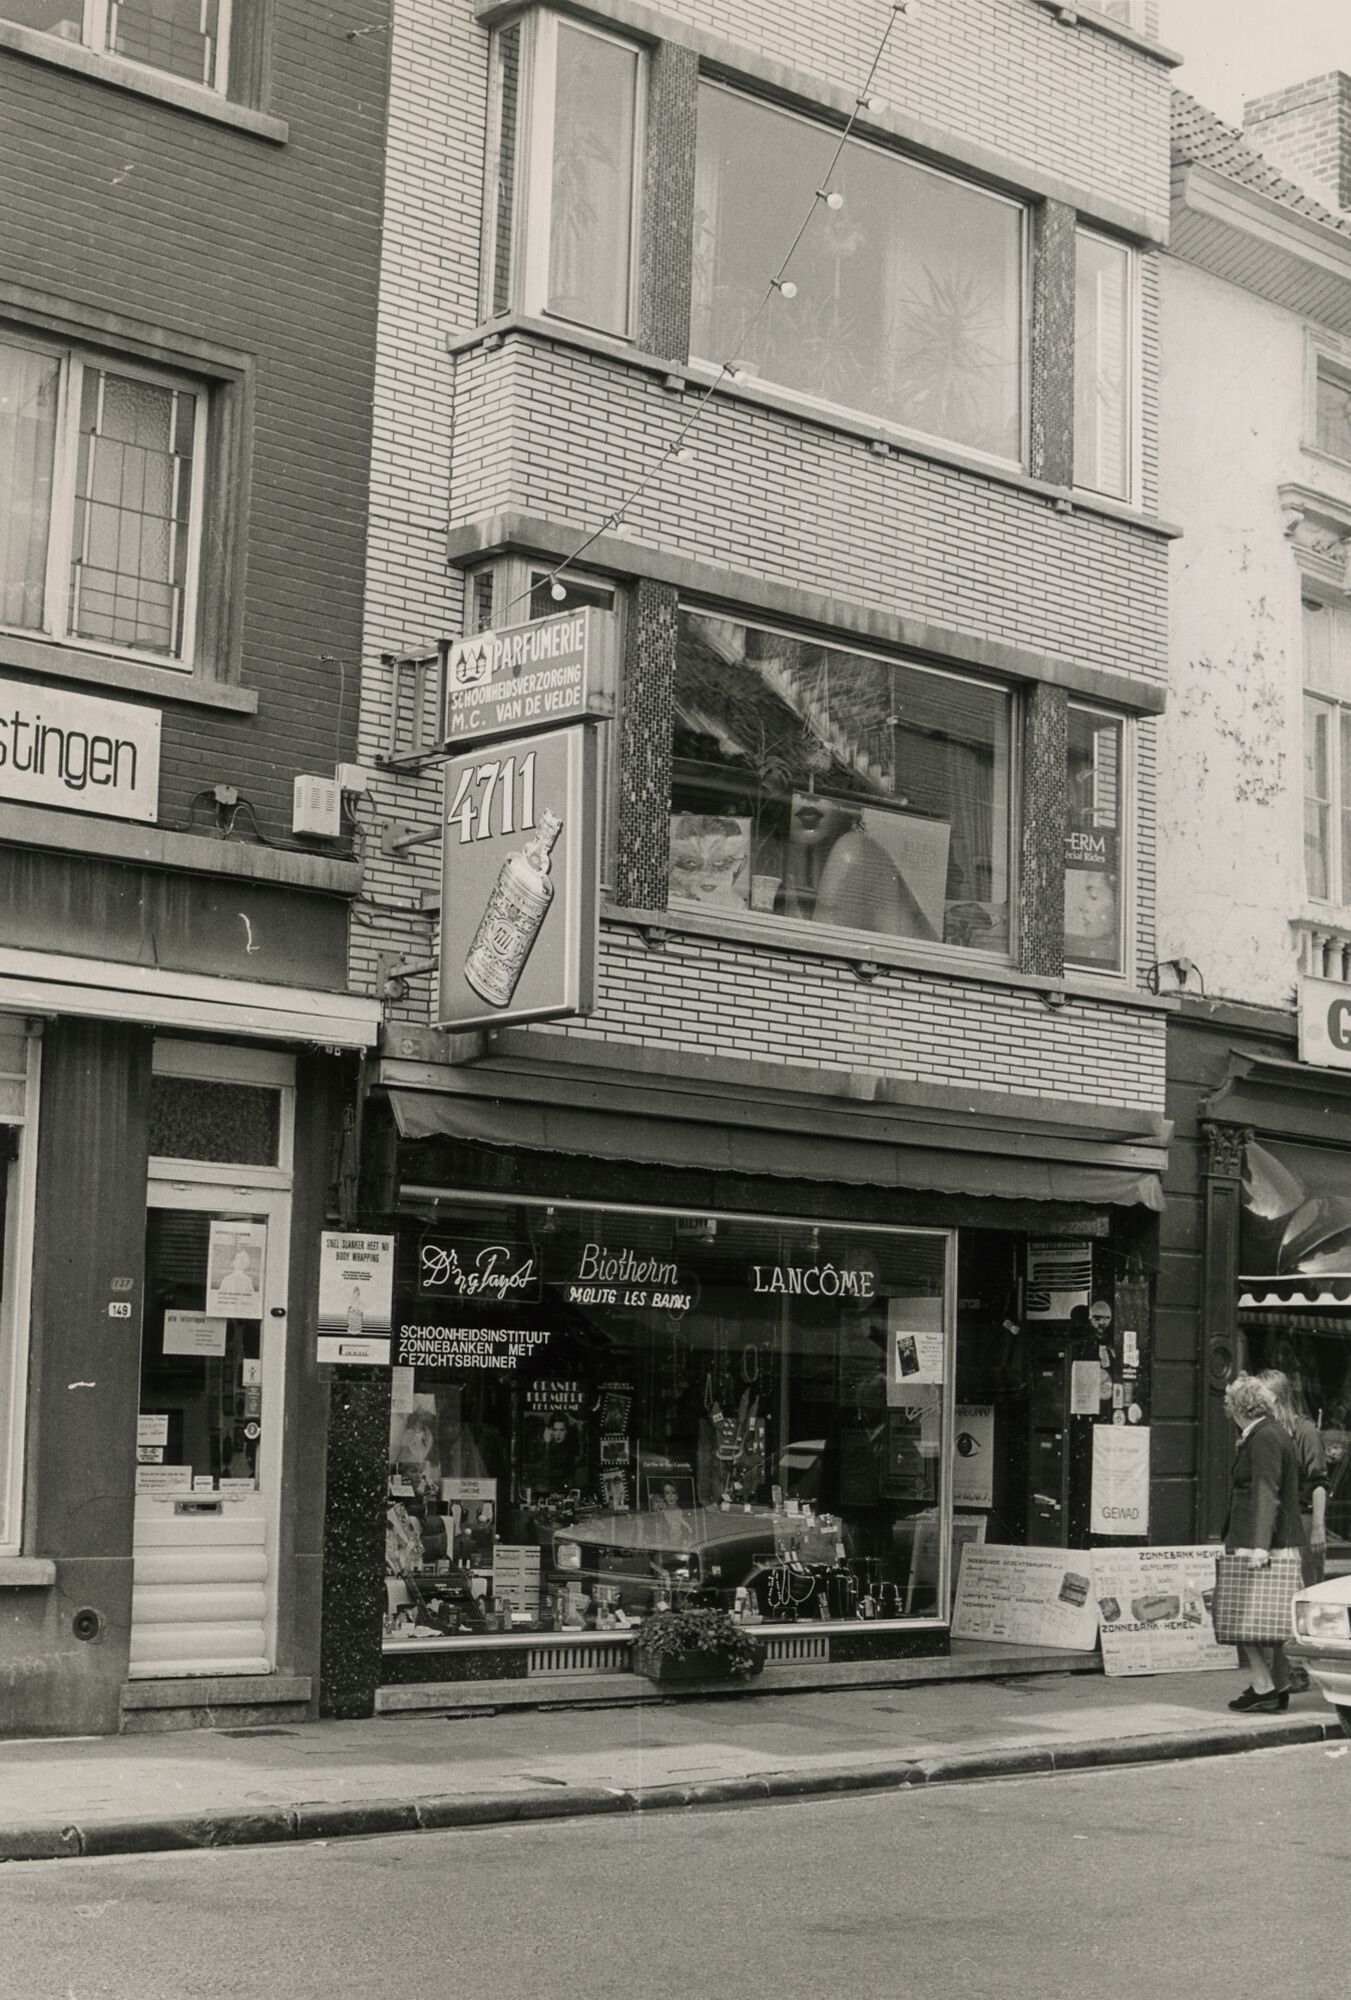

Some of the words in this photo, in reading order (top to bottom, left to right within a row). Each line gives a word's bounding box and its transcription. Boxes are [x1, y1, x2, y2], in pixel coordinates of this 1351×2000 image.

[493, 618, 585, 671] PARFUMERIE
[450, 664, 582, 711] SCHOONHEIDSVERZORGING
[496, 700, 522, 723] VAN
[525, 697, 542, 717] DE
[544, 686, 582, 711] VELDE
[447, 751, 537, 844] 4711
[1063, 832, 1106, 853] ERM
[336, 1250, 350, 1262] BODY
[352, 1252, 380, 1263] WRAPPING
[578, 1243, 679, 1285] Biotherm
[475, 1245, 538, 1300] Payot
[753, 1262, 875, 1298] LANCÔME
[112, 1304, 129, 1316] 149
[624, 1290, 647, 1307] LES
[652, 1292, 692, 1310] BAINS
[400, 1325, 551, 1344] SCHOONHEIDSINSTITUUT
[400, 1339, 494, 1355] ZONNEBANKEN
[508, 1343, 535, 1357] MET
[1139, 1551, 1194, 1560] ZONNEBANK
[1102, 1621, 1159, 1633] ZONNEBANK
